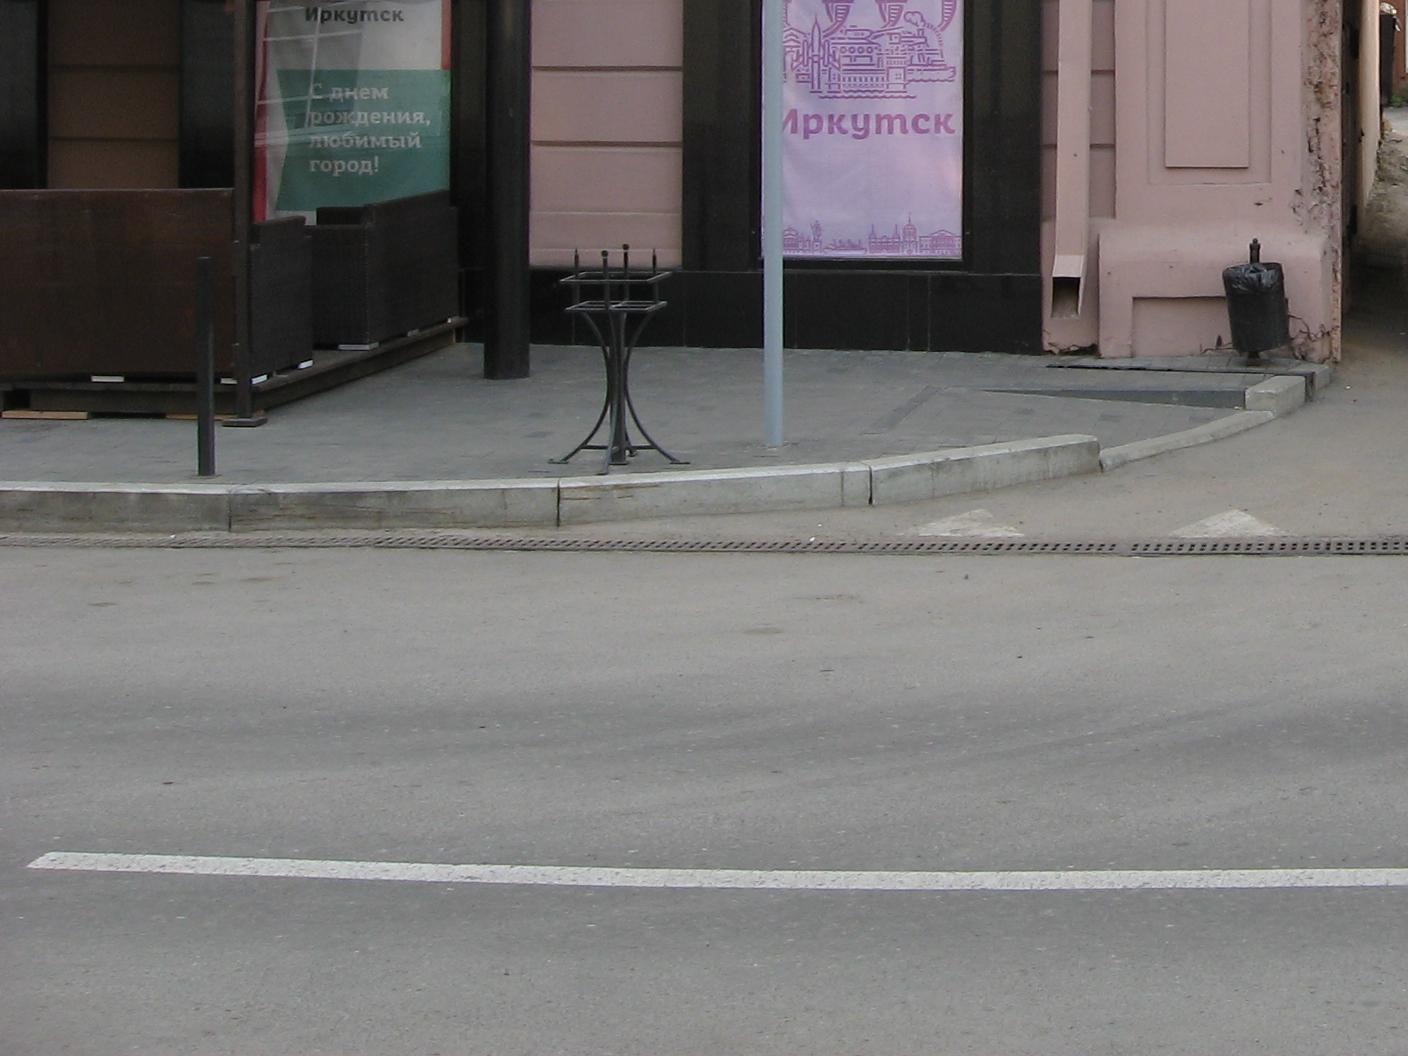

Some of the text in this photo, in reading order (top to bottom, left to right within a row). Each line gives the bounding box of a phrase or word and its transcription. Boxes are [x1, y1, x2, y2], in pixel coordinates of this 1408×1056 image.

[304, 6, 405, 24] Иркутск
[330, 87, 390, 102] днем
[309, 111, 431, 127] рождения,
[309, 131, 422, 148] любимый
[309, 156, 379, 176] город!
